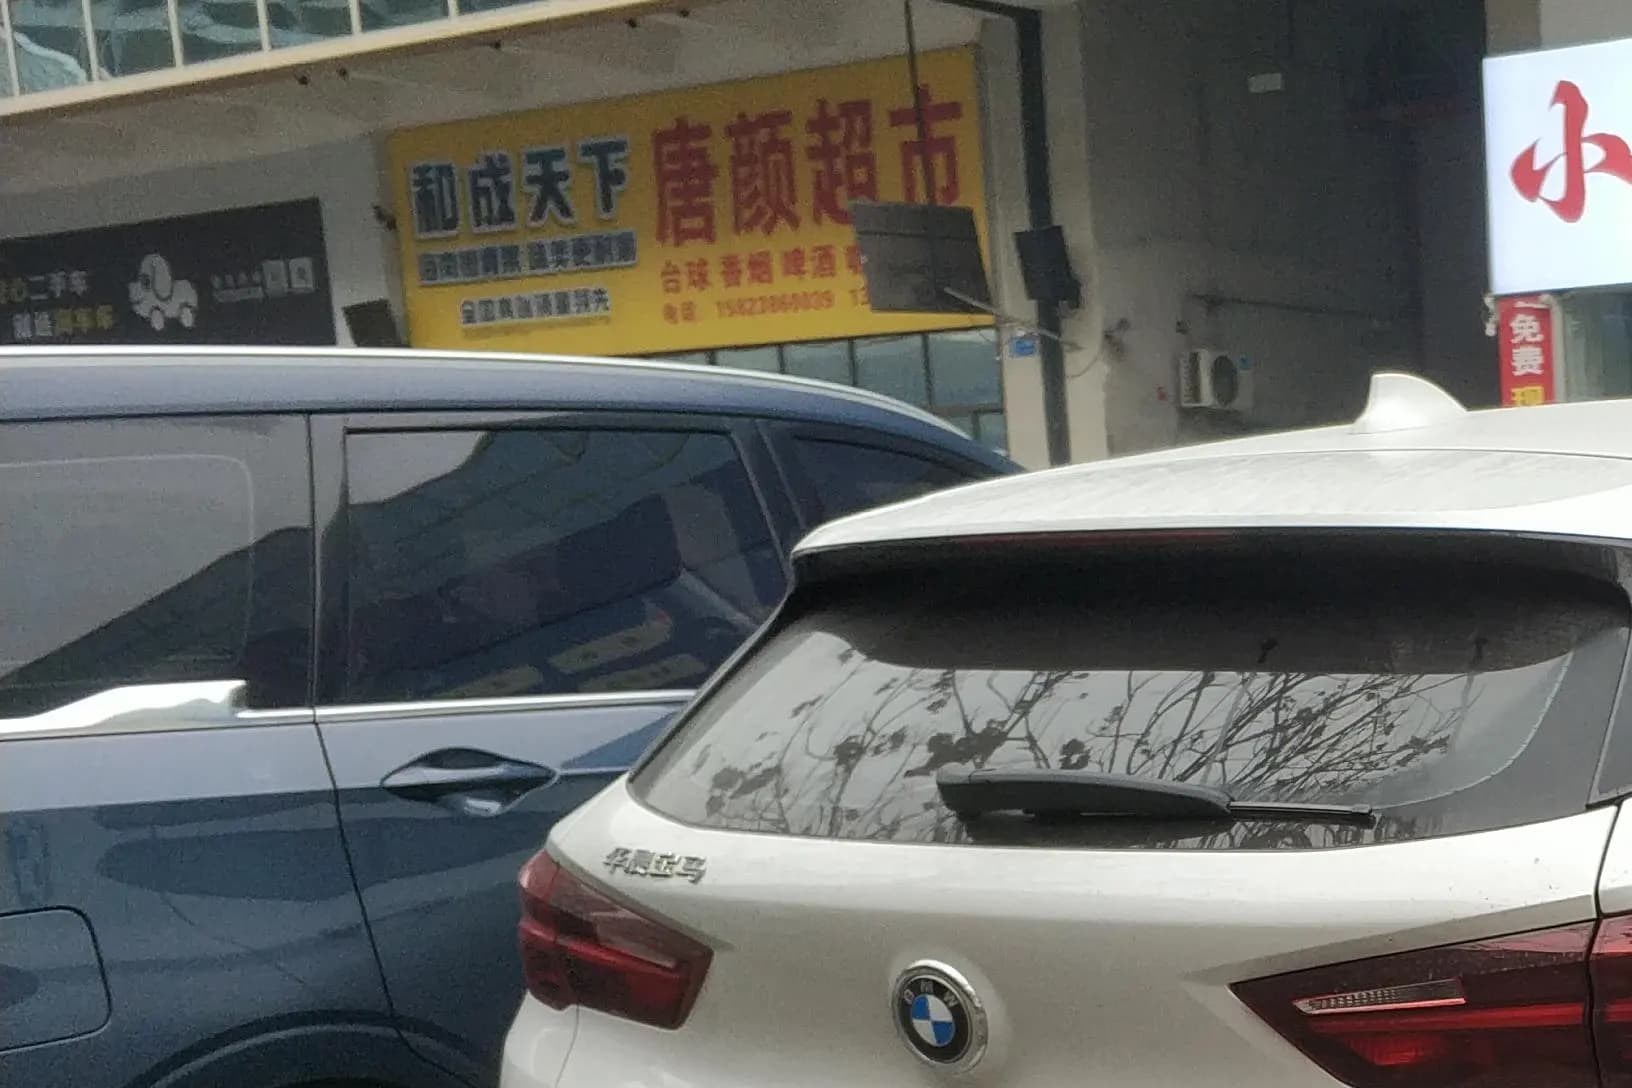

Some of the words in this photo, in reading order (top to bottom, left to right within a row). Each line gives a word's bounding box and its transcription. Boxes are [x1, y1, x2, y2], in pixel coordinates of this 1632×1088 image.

[652, 84, 962, 246] 唐颜超市
[603, 847, 706, 885] 华晨宝马
